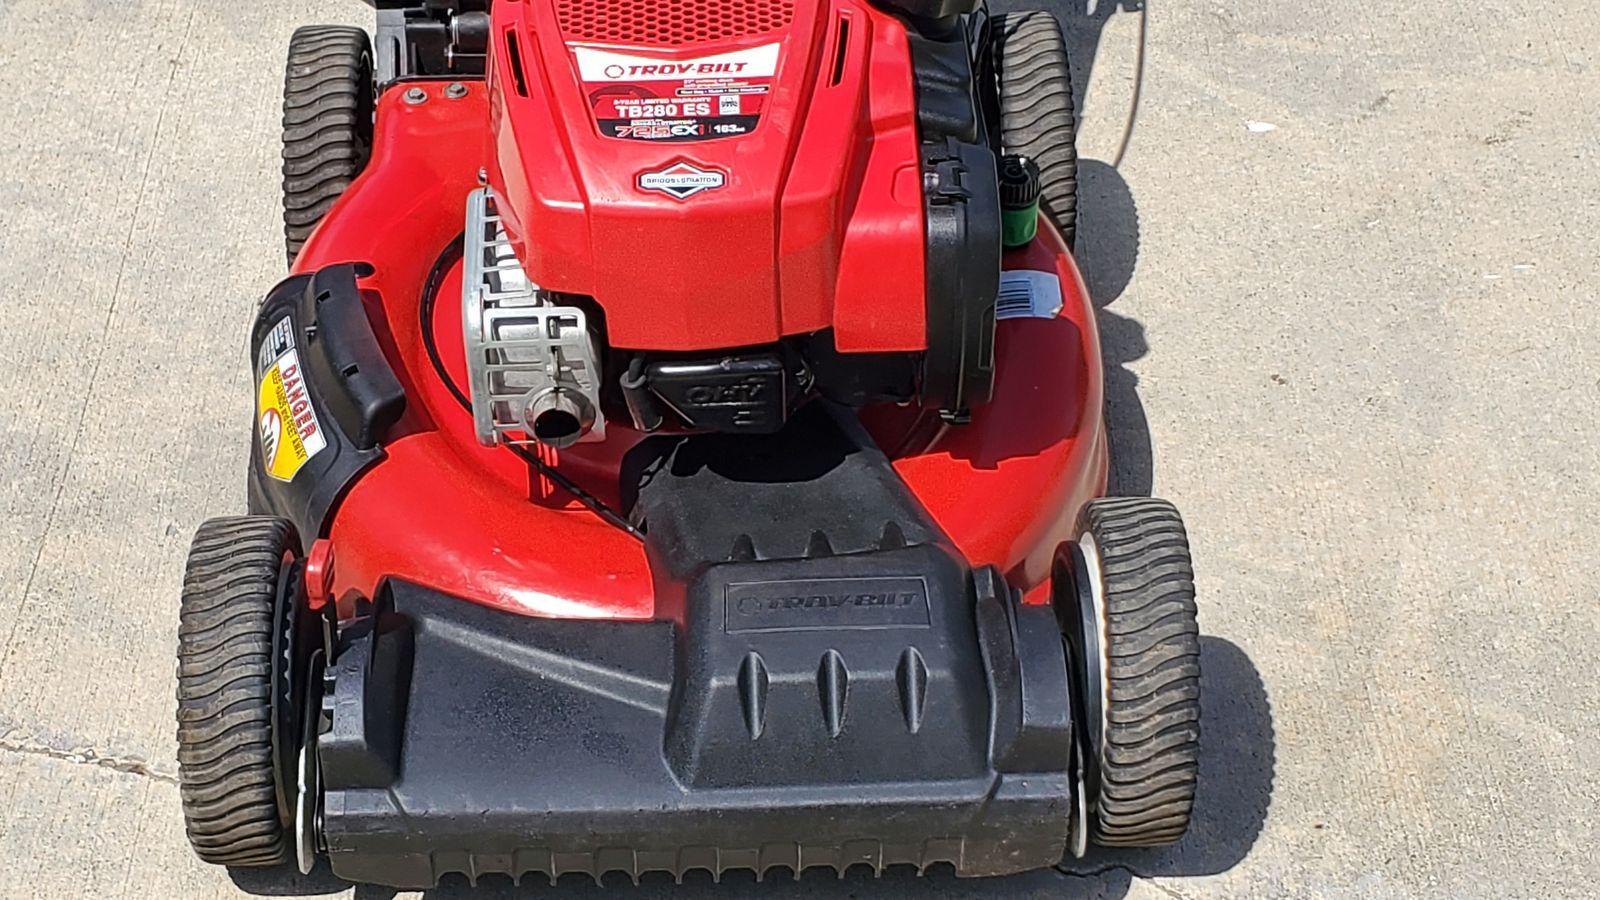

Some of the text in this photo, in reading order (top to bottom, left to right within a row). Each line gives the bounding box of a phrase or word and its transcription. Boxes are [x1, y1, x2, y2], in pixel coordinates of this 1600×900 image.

[628, 62, 748, 76] TROY-BILT
[614, 104, 677, 118] TB280
[683, 103, 711, 117] ES
[281, 364, 316, 441] DANGER
[285, 418, 298, 438] FEET
[291, 436, 307, 460] AWAY
